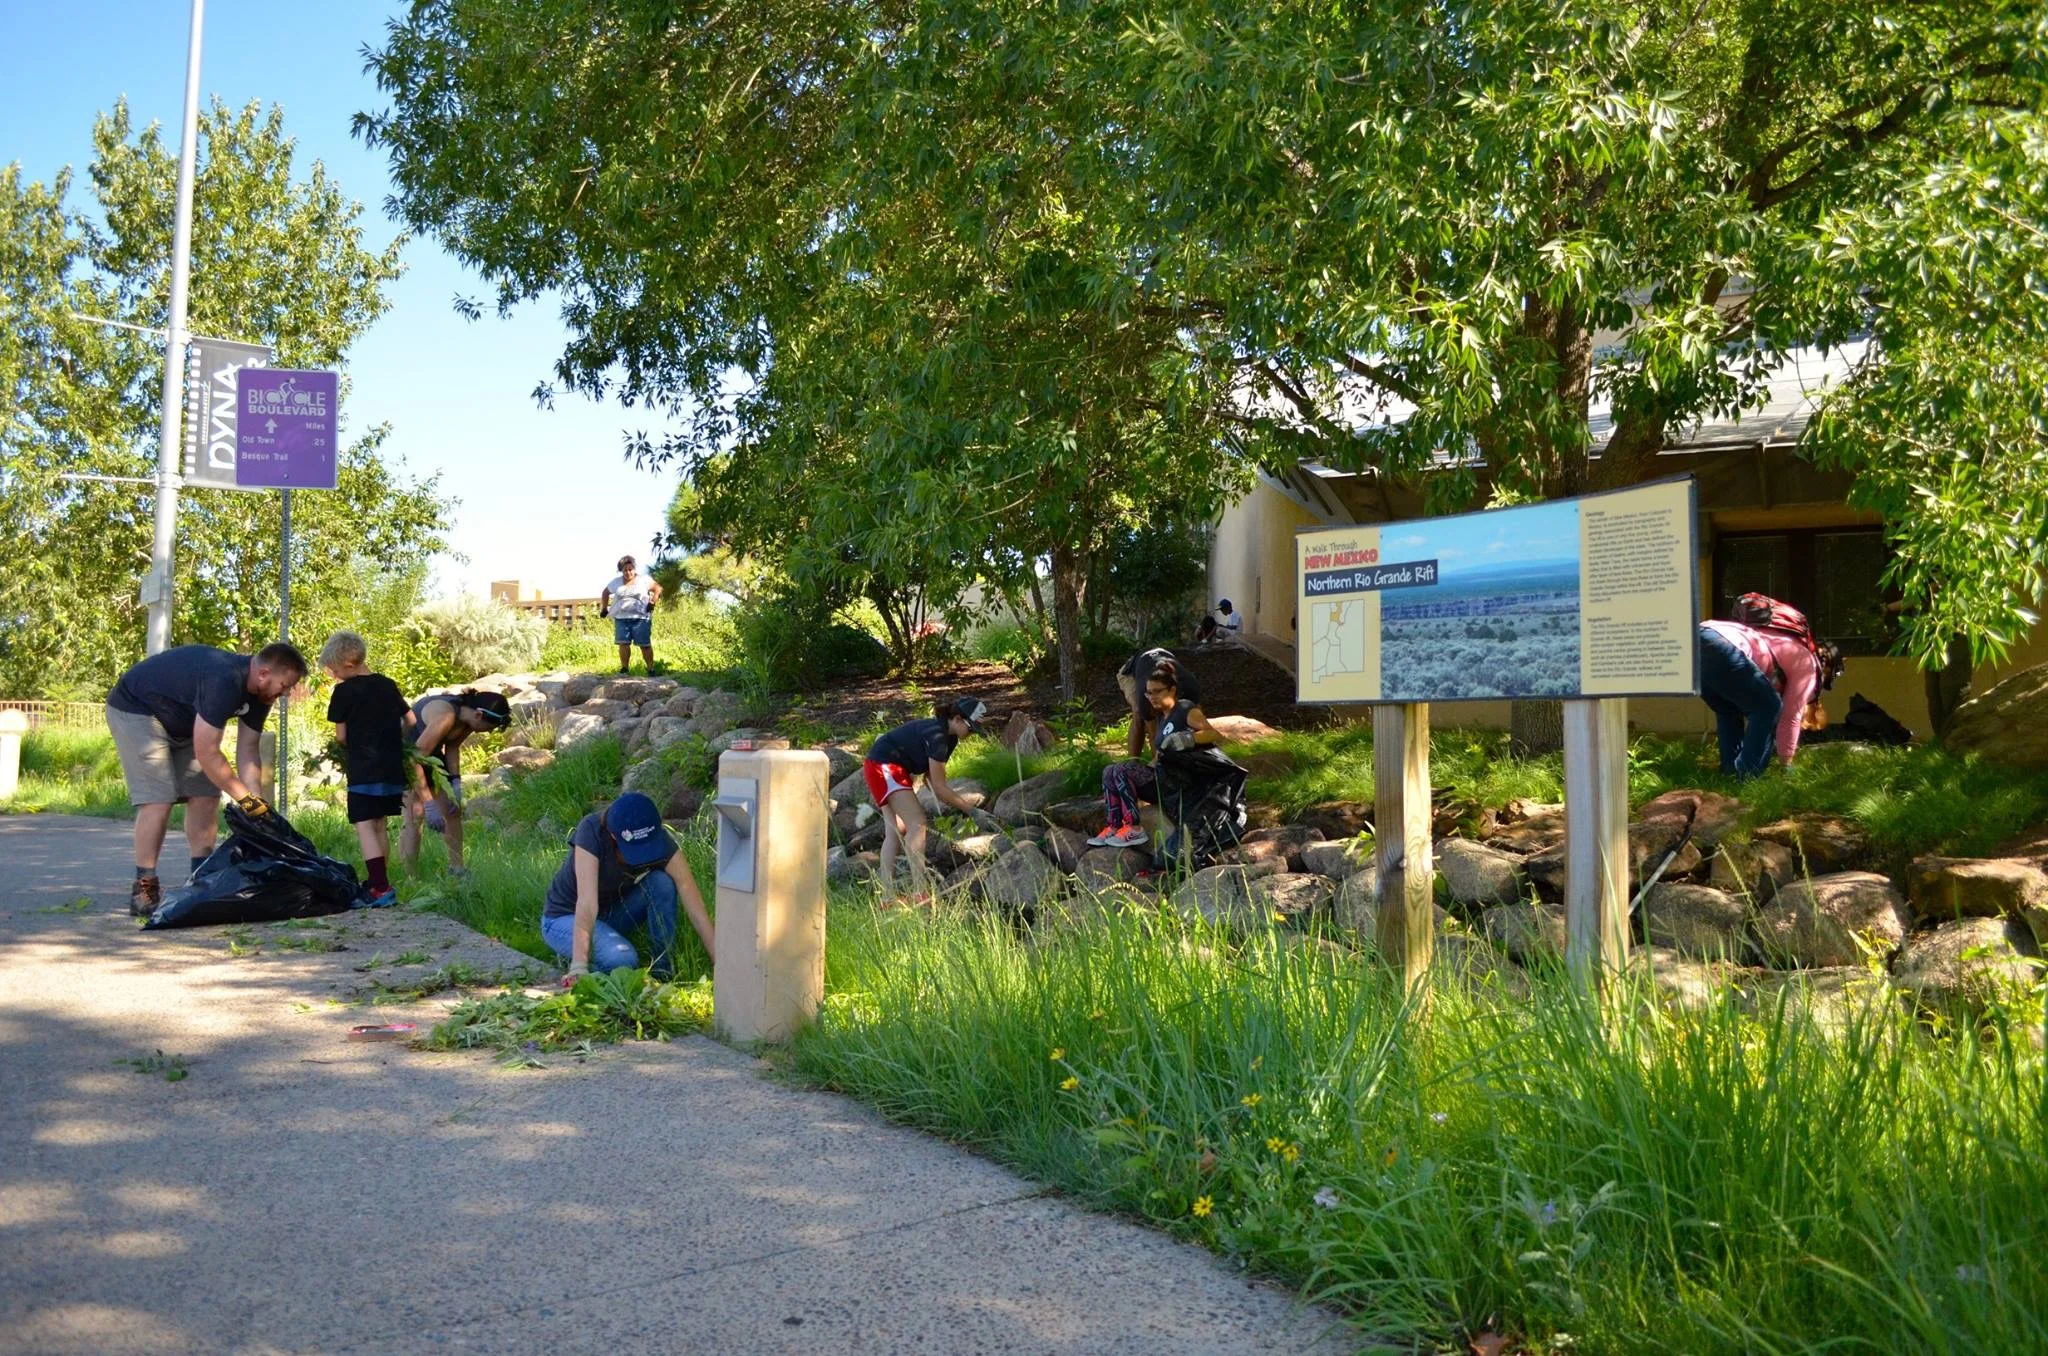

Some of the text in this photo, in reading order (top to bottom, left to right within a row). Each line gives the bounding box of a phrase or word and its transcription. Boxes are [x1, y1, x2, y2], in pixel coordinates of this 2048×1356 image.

[248, 388, 326, 407] BICYCLE
[248, 405, 326, 417] BOULEVARD
[305, 422, 326, 431] Miles
[242, 436, 255, 444] Old
[257, 436, 276, 445] Town
[273, 453, 289, 461] Trail
[1304, 545, 1311, 554] A
[1330, 539, 1358, 553] Through
[1304, 548, 1378, 570] NEW MEXICO
[1307, 564, 1435, 592] Northern Rio Grande Rift
